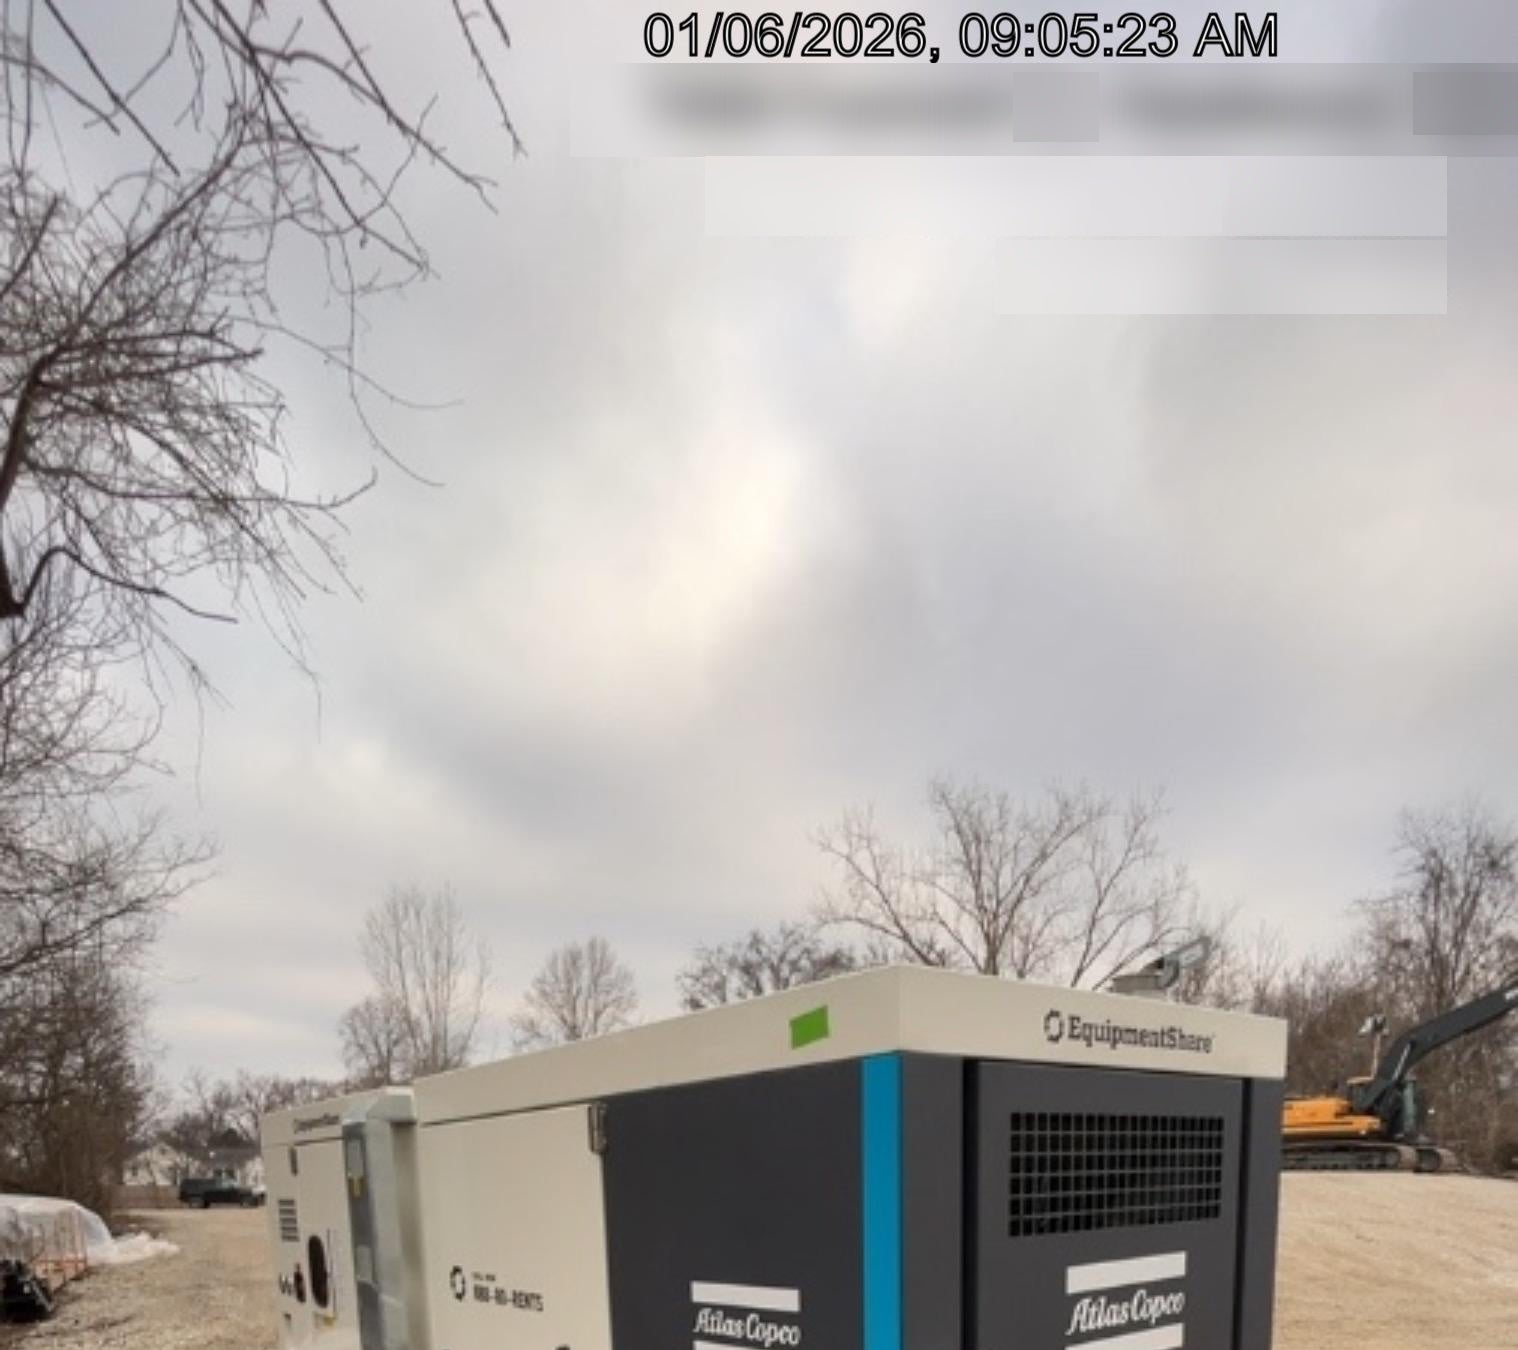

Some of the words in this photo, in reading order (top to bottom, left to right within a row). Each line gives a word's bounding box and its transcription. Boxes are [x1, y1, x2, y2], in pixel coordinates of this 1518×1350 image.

[1067, 1015, 1213, 1053] EquipmentShare
[693, 1307, 745, 1339] Atlas
[746, 1313, 801, 1348] Copco
[1065, 1295, 1130, 1336] Atlas
[1130, 1289, 1185, 1324] Copco
